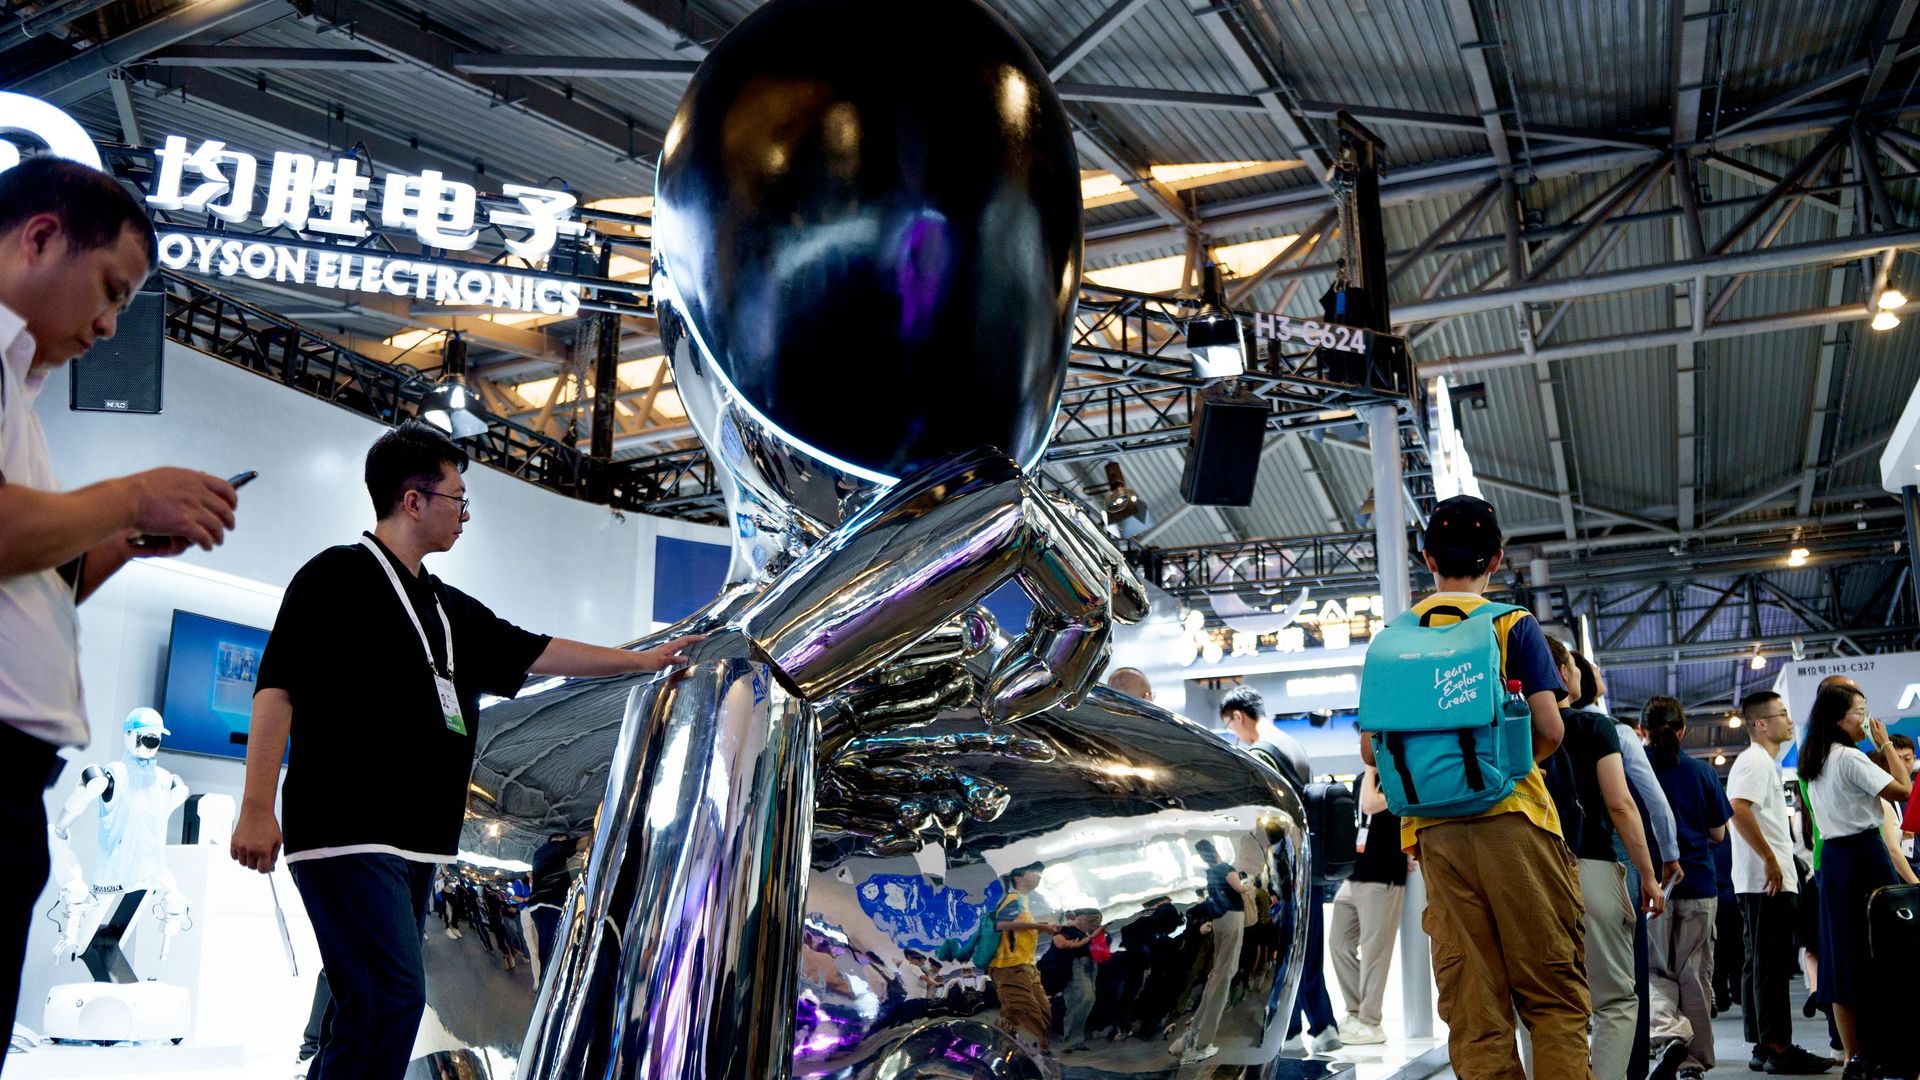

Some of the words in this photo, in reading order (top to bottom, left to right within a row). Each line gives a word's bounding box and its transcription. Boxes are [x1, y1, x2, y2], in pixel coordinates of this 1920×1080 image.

[145, 135, 586, 258] 均胜电子
[156, 231, 307, 284] OYSON
[316, 251, 581, 316] ELECTRONICS
[1255, 312, 1366, 354] H3-C624
[1433, 662, 1472, 689] Learn
[1443, 672, 1484, 697] Explore
[1438, 687, 1479, 709] Create
